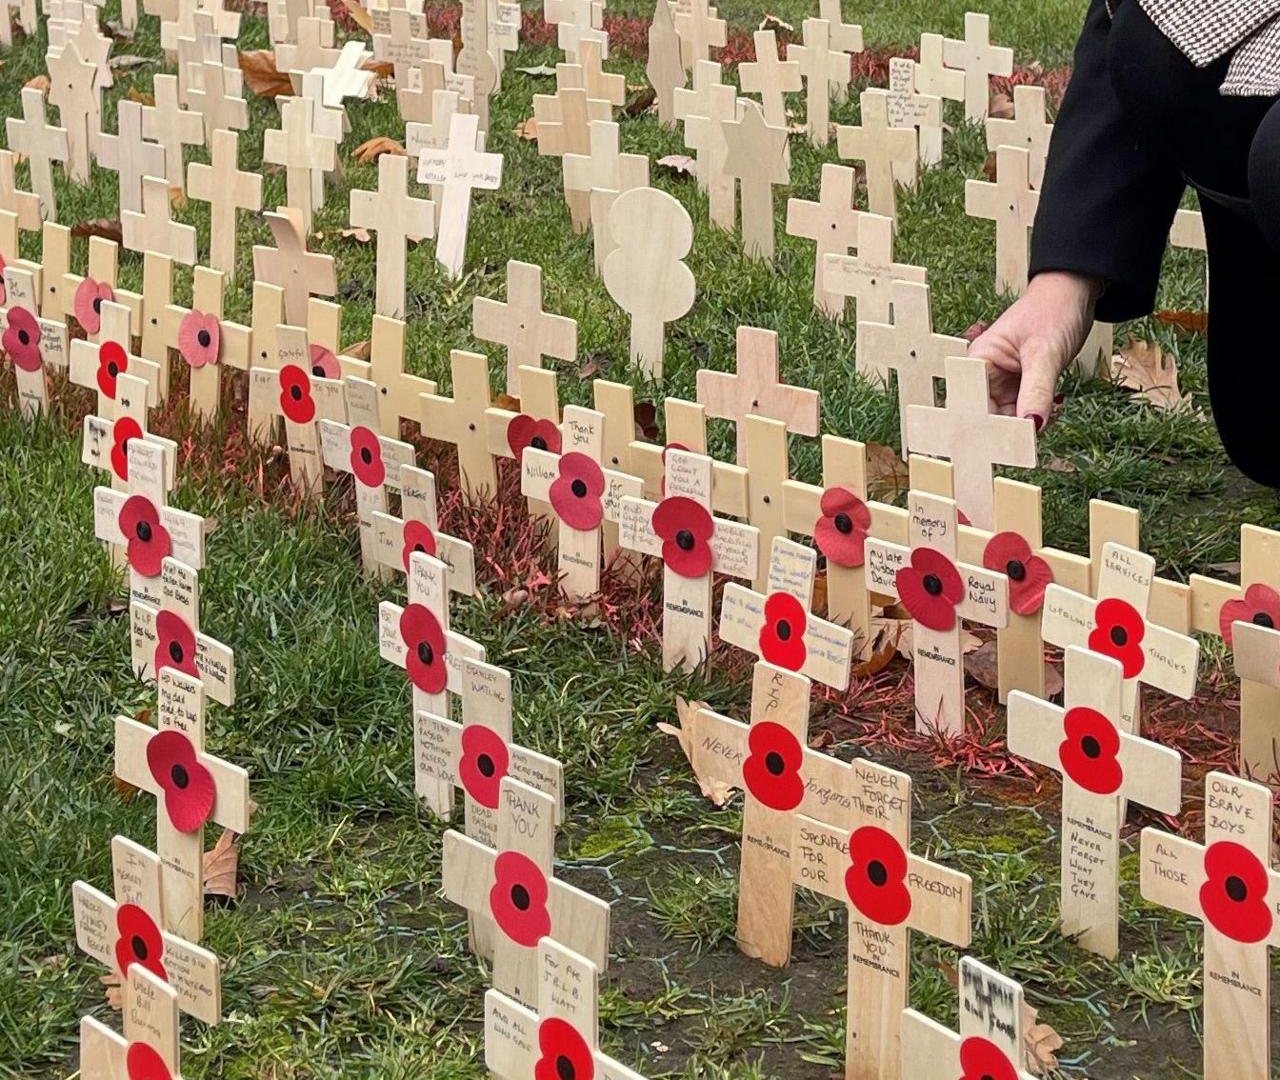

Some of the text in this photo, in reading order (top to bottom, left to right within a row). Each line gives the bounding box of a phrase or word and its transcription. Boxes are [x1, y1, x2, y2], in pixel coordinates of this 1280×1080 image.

[569, 420, 595, 435] Thank
[573, 432, 589, 446] you
[525, 464, 555, 480] William
[915, 504, 924, 513] In
[912, 514, 947, 536] memory
[921, 528, 933, 542] of
[870, 550, 903, 564] my late
[1112, 551, 1132, 565] ALL
[1105, 559, 1149, 587] SERVICES
[968, 576, 995, 594] Royal
[665, 602, 704, 619] REMEMBRANCE
[969, 591, 996, 613] Navy
[918, 648, 956, 666] REMEMBRANCE
[701, 736, 744, 767] NEVER
[856, 768, 899, 790] NEVER
[1212, 781, 1244, 799] OUR
[502, 789, 541, 819] THANK
[852, 795, 890, 821] THEIR
[862, 785, 906, 814] FORGET
[1207, 795, 1254, 820] BRAVE
[511, 817, 539, 839] YOU
[1067, 817, 1112, 840] REMEMBRANCE
[1208, 816, 1246, 834] BOYS
[746, 835, 791, 859] REMEMBRANCE
[798, 844, 827, 866] FOR
[1155, 843, 1178, 860] ALL
[801, 867, 829, 884] OUR
[1149, 860, 1188, 886] THOSE
[908, 872, 962, 903] FREEDOM
[854, 921, 895, 946] THANK
[852, 954, 900, 978] REMEMBRANCE
[1231, 971, 1240, 979] IN
[1209, 972, 1262, 997] REMEMBRANCE
